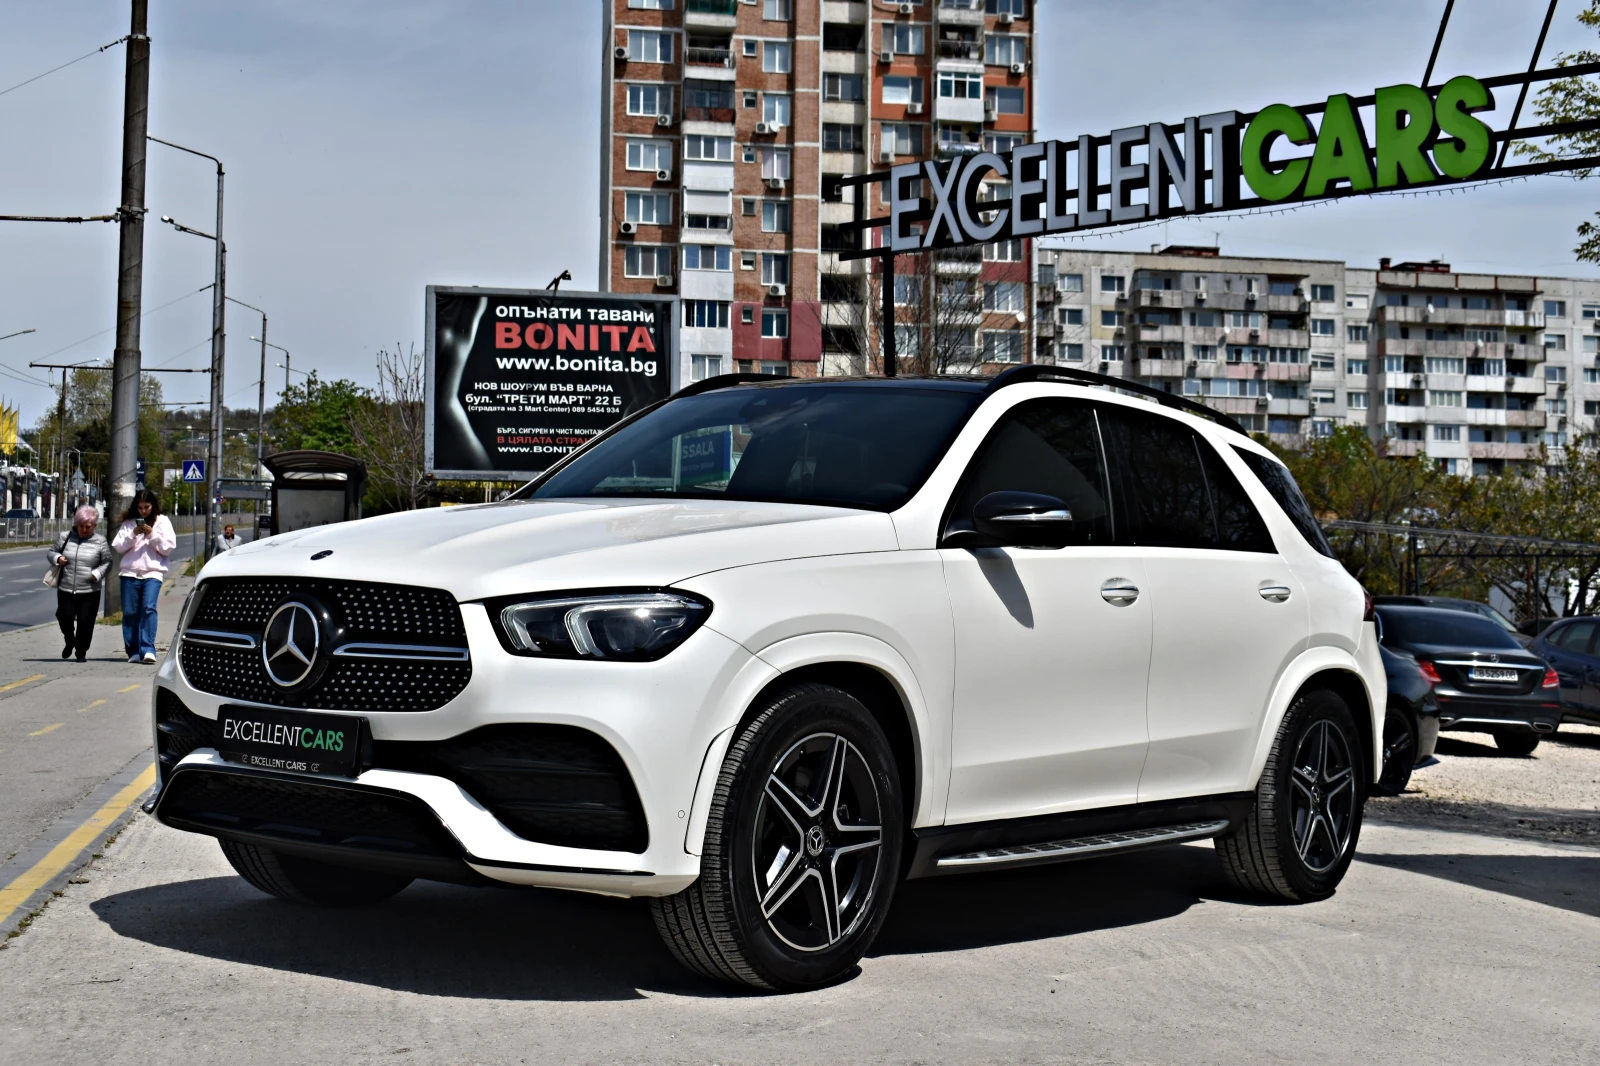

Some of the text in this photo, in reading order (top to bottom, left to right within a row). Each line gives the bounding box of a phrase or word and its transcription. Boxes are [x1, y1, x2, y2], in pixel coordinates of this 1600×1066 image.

[495, 305, 655, 323] опънати тавани
[495, 321, 656, 352] BONITA
[495, 355, 657, 377] www.bonita.bg
[474, 382, 614, 392] НОВ ШОУРУМ ВЪВ ВАРНА
[465, 394, 493, 405] бул.
[594, 396, 609, 405] 22
[467, 404, 506, 413] (сградата
[543, 405, 571, 413] Center)
[497, 436, 505, 444] В
[508, 436, 553, 445] ЦЯЛАТА
[497, 445, 580, 453] www.BONIT
[251, 755, 286, 769] EXCELLENT
[285, 760, 307, 771] CARS
